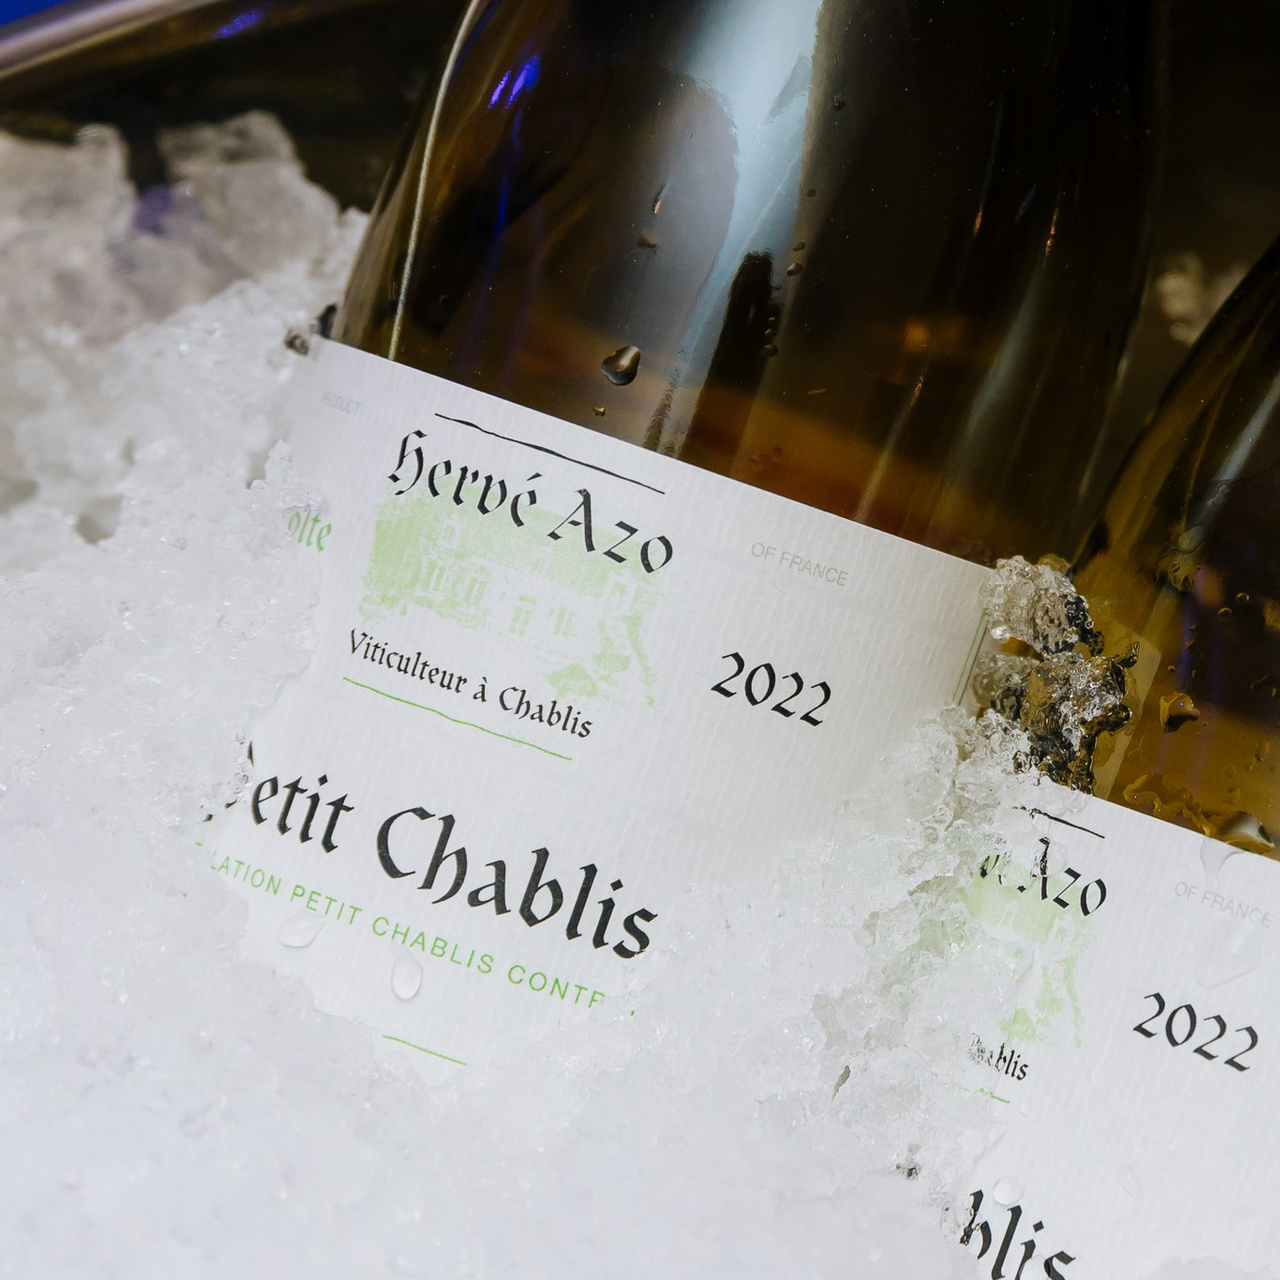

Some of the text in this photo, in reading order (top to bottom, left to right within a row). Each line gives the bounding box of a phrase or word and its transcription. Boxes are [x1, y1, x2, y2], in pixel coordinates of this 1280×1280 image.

[286, 508, 333, 552] olte
[387, 429, 674, 574] Hervé Azo
[751, 542, 850, 587] OF FRANCE
[350, 628, 593, 738] Viticulteur à Chablis
[711, 652, 833, 728] 2022
[203, 741, 659, 960] etit Chablis
[289, 883, 363, 925] PETIT
[371, 915, 495, 975] CHABLIS
[1174, 880, 1275, 929] OF FRANCE
[1132, 992, 1260, 1072] 2022
